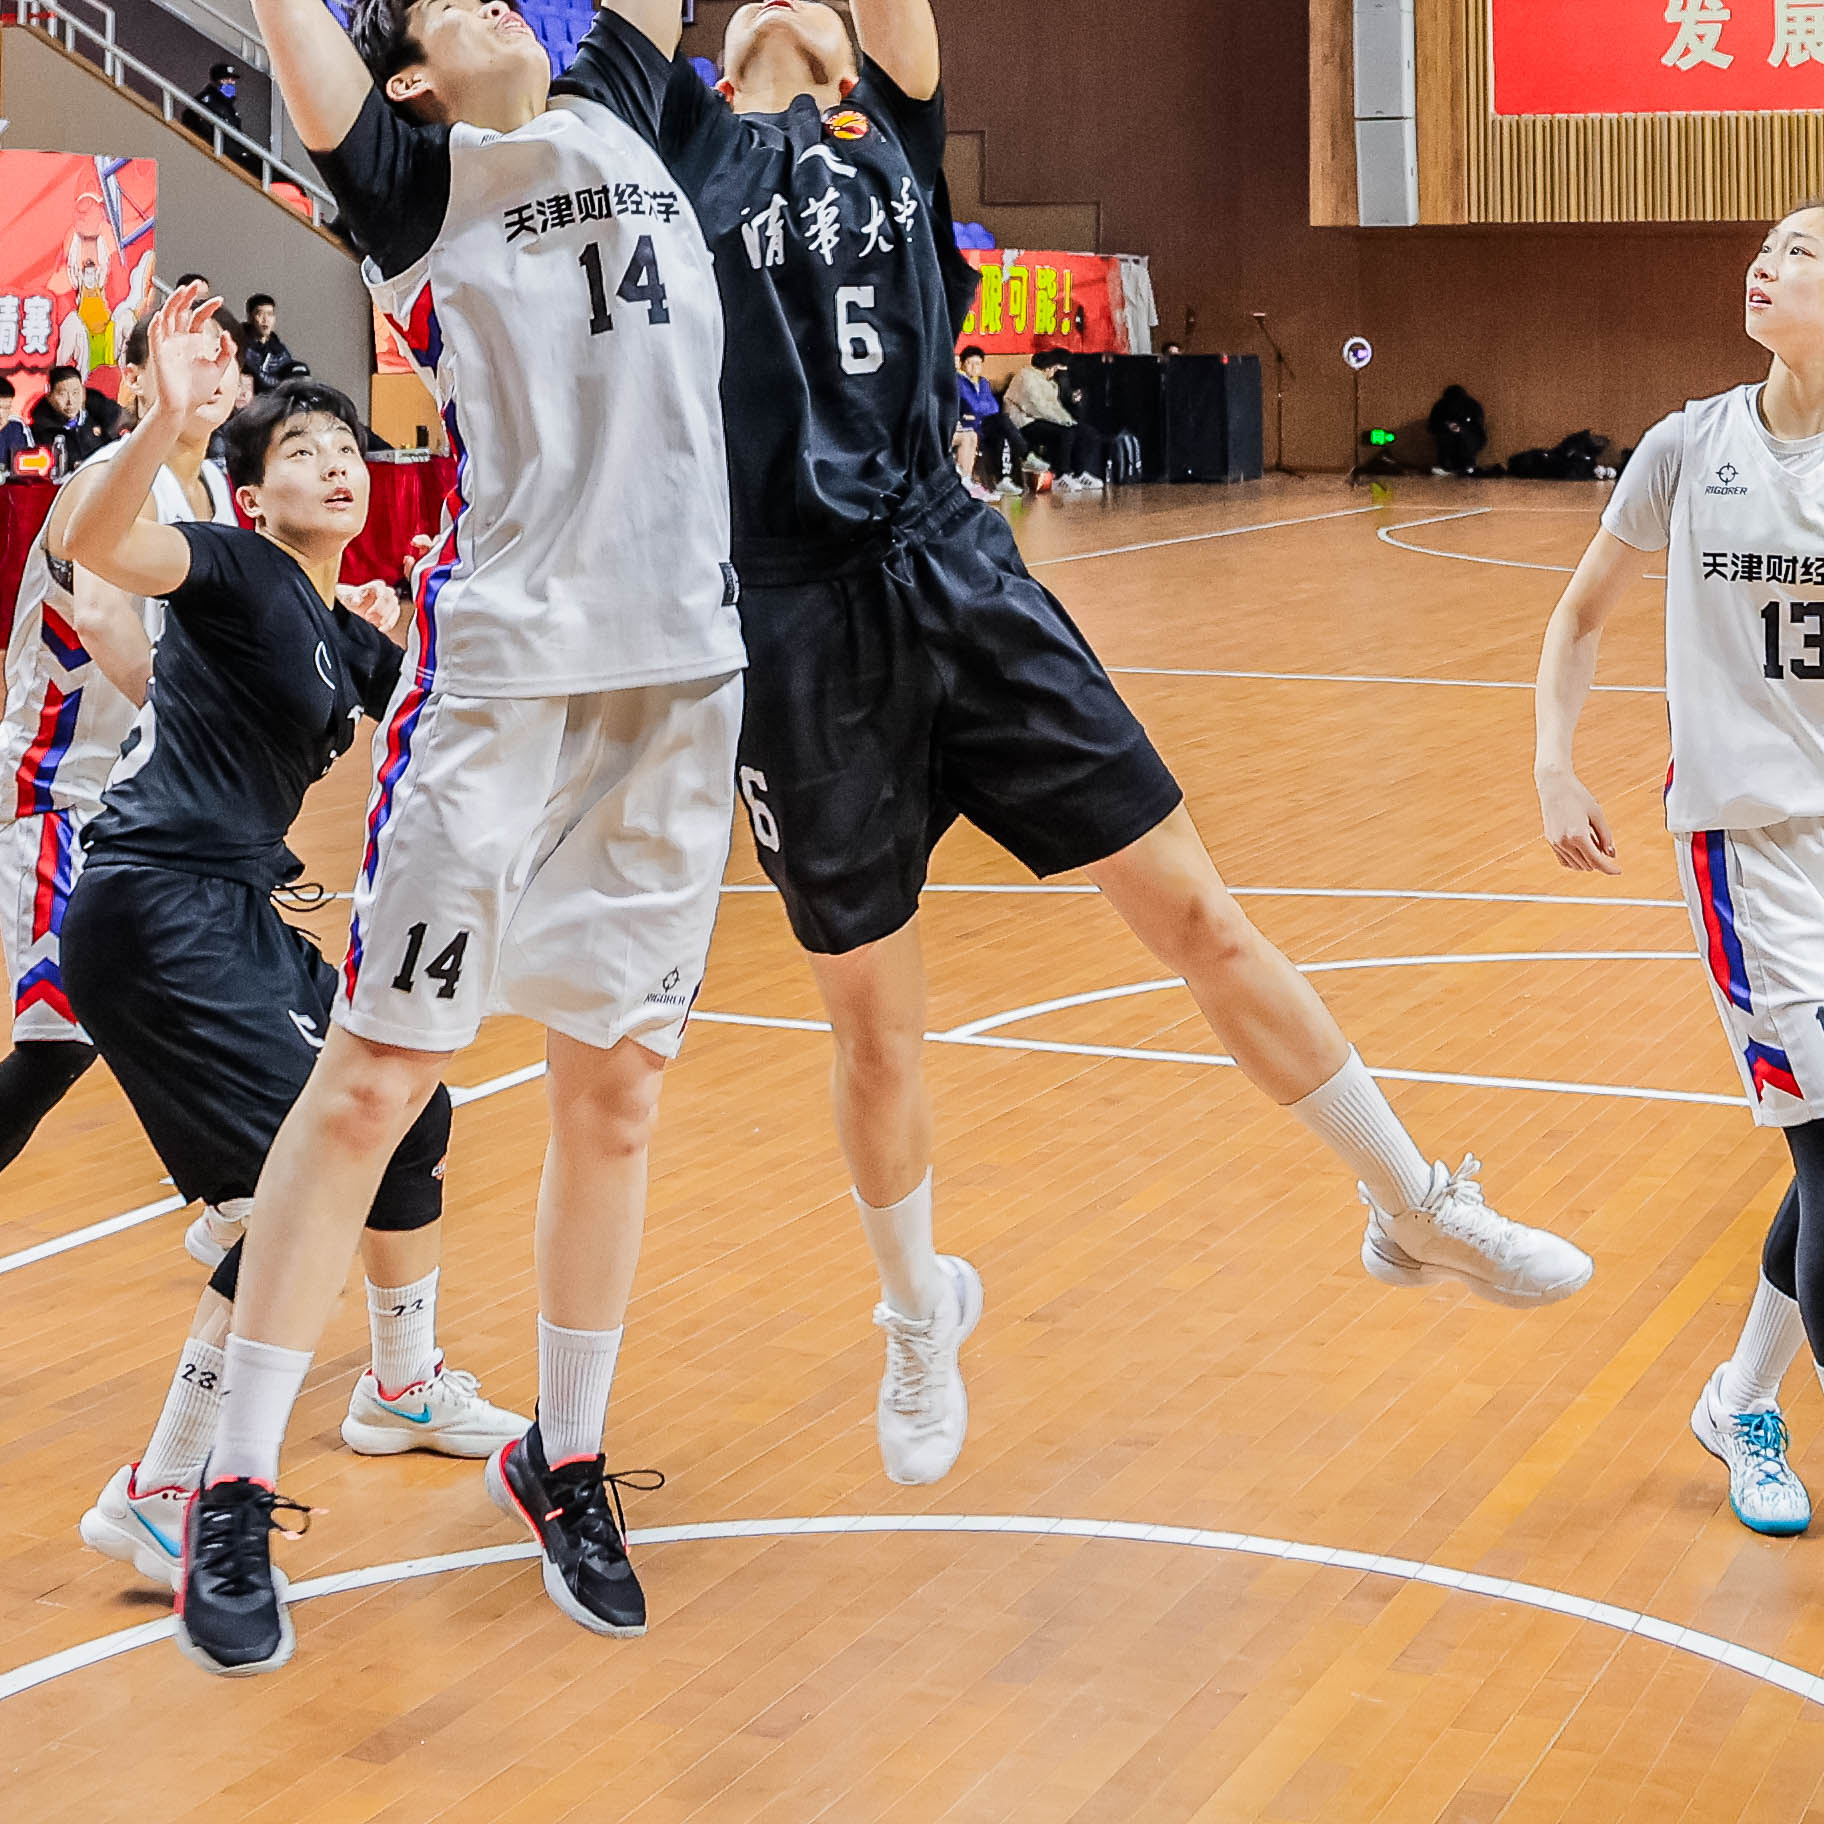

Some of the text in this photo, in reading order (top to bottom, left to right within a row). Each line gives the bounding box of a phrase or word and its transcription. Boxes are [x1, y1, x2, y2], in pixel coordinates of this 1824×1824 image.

[578, 233, 671, 336] 14
[963, 265, 1072, 334] 限可能！
[833, 284, 885, 376] 6
[1704, 485, 1748, 497] RIGORER
[739, 765, 780, 853] 6
[391, 921, 469, 999] 14
